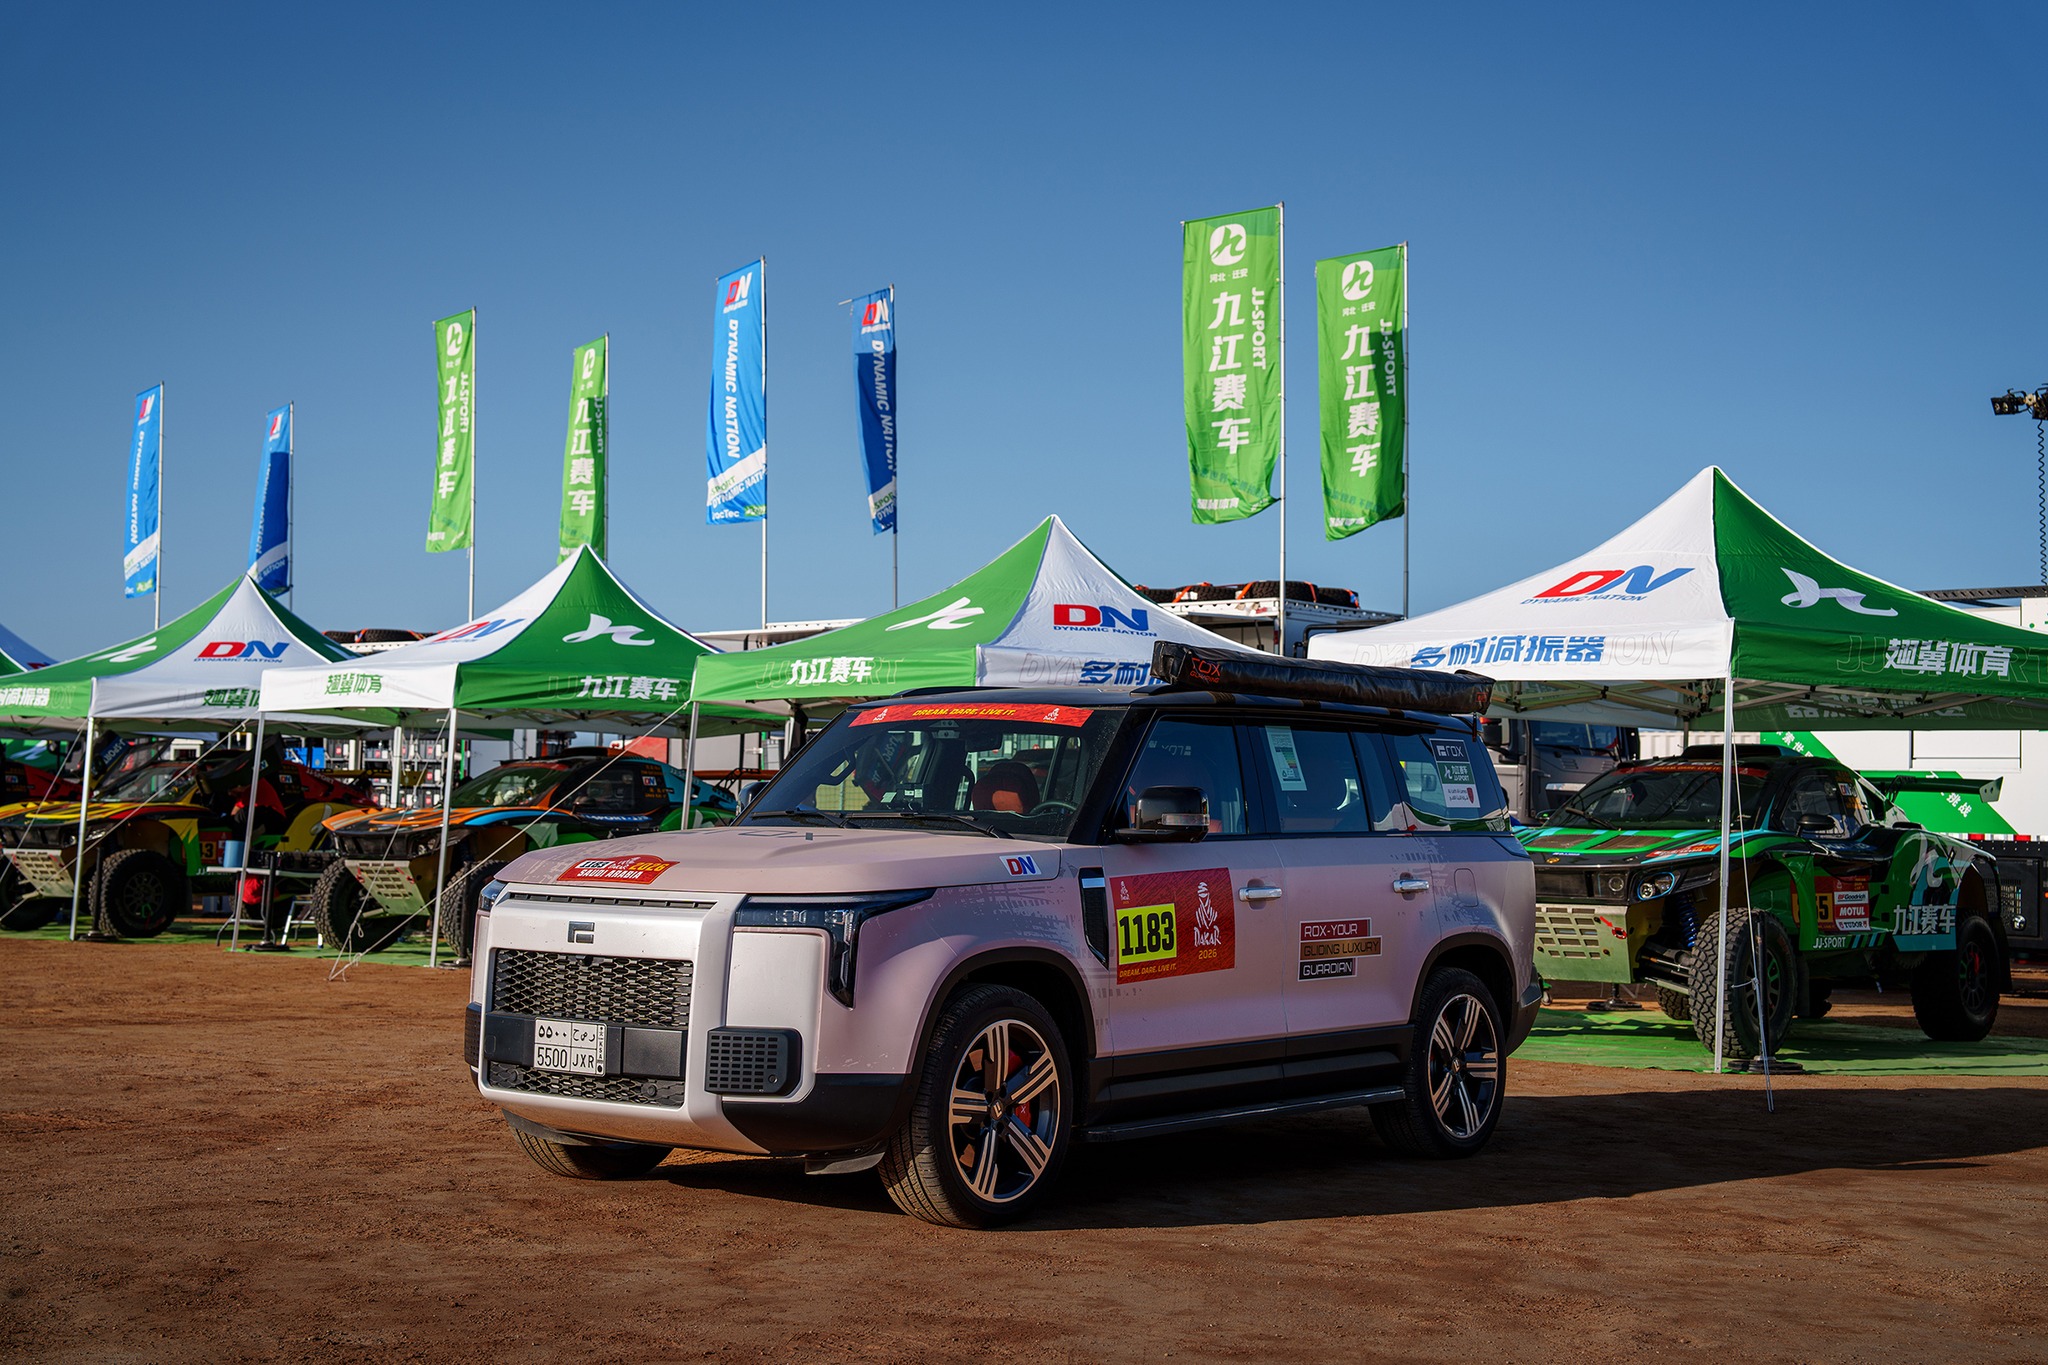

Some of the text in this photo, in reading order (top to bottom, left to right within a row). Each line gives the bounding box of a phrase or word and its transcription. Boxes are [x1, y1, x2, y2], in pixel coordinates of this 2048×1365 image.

[725, 272, 753, 305] DN
[863, 299, 889, 325] DN
[1251, 287, 1267, 370] JJ-SPORT
[725, 318, 739, 393] DYNAMIC
[1380, 318, 1397, 397] JJ-SPORT
[871, 339, 890, 411] DYNAMIC
[1207, 291, 1251, 455] 九江赛车
[1340, 324, 1381, 478] 九江赛车
[438, 375, 457, 499] 九江赛车
[725, 396, 741, 459] NATION
[567, 397, 596, 517] 九江赛车
[711, 482, 745, 509] DYNAMIC
[130, 493, 139, 545] NATION
[1533, 564, 1695, 599] DN
[1520, 592, 1648, 605] DYNAMIC NATION
[431, 618, 526, 642] DN
[1053, 604, 1149, 632] DN
[1053, 625, 1158, 637] DYNAMIC NATION
[197, 640, 290, 659] DN
[1410, 634, 1607, 669] 多耐减振器
[786, 656, 874, 685] 九江赛车
[1079, 659, 1171, 687] 多耐
[576, 675, 680, 701] 九江赛车
[577, 869, 644, 879] SAUDI ARABIA
[629, 861, 670, 872] 2026
[1005, 854, 1037, 876] DN
[1839, 906, 1865, 917] MOTUL
[1843, 920, 1863, 929] TUDOR
[1892, 903, 1957, 935] 九江赛车
[1119, 911, 1175, 957] 1183
[1304, 923, 1358, 937] ROX-YOUR
[1813, 936, 1846, 949] JJ-SPORT
[1198, 948, 1218, 960] 2026
[1303, 941, 1379, 957] GLIDING LUXURY
[1157, 964, 1170, 973] LIVE
[1303, 961, 1352, 976] GUARDIAN
[536, 1046, 568, 1069] 5500
